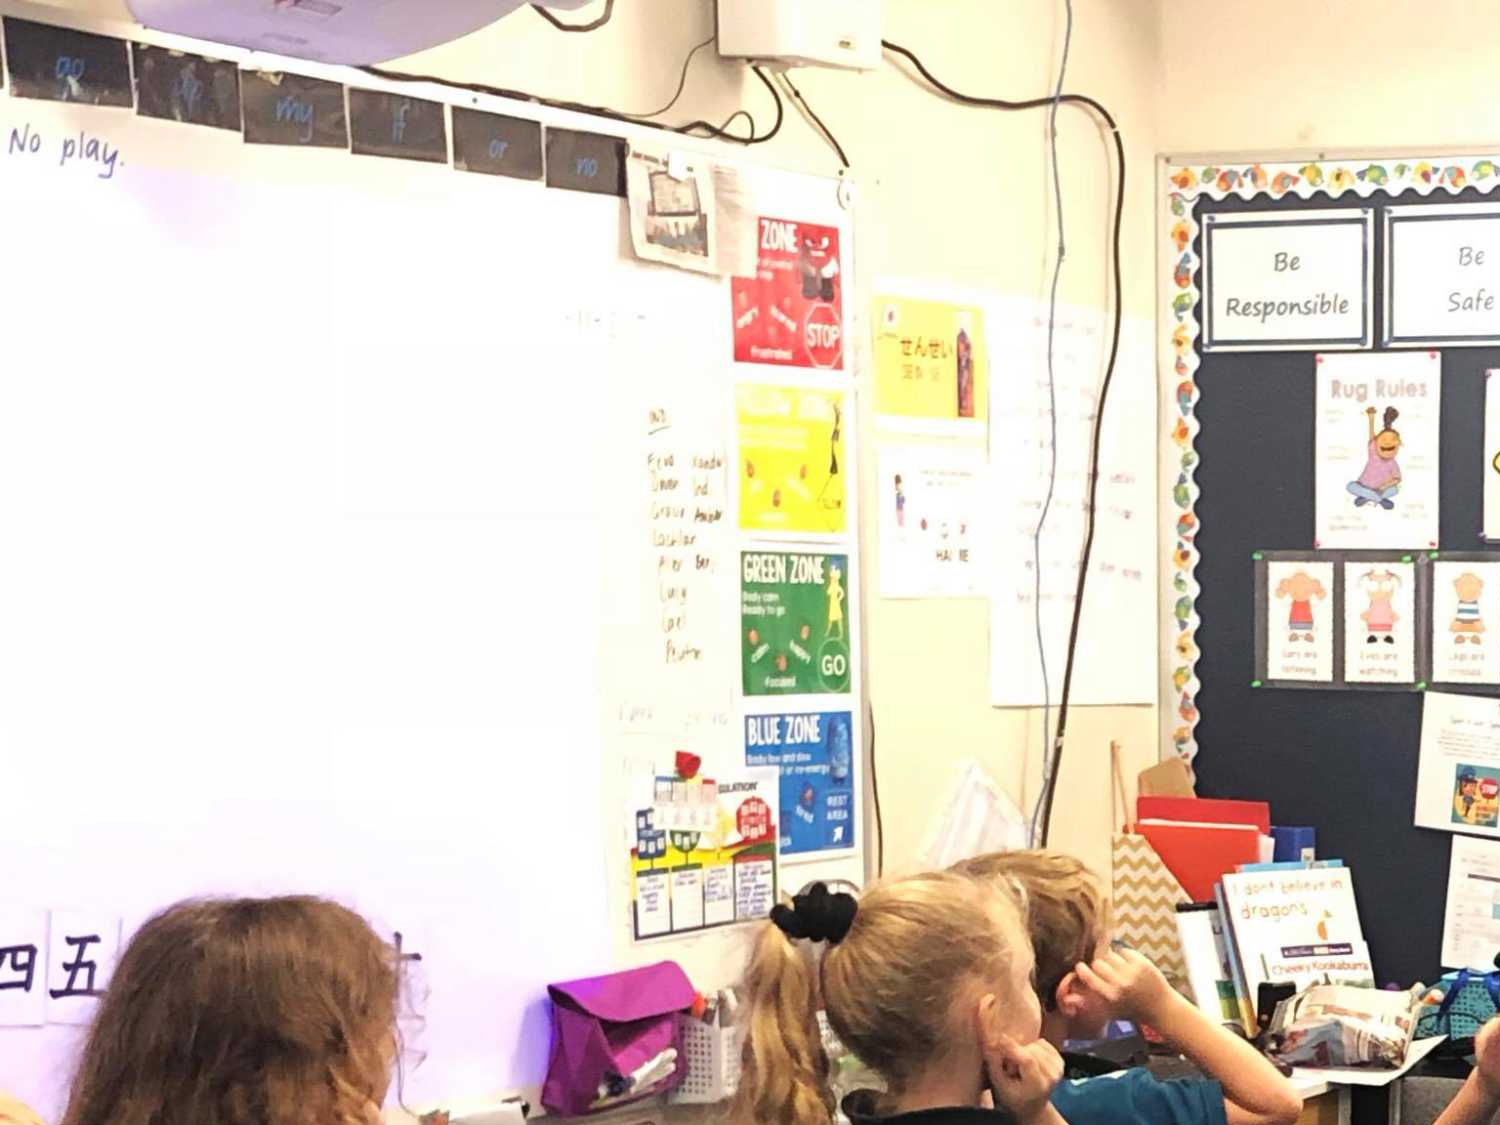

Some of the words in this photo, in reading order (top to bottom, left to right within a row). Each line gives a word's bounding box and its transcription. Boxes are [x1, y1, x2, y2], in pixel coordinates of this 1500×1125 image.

[9, 123, 41, 154] No
[60, 131, 124, 179] play.
[760, 219, 799, 253] ZONE
[1274, 252, 1301, 272] Be
[1458, 247, 1485, 266] Be
[1225, 293, 1350, 323] Responsible
[1448, 288, 1495, 312] Safe
[807, 322, 840, 348] STOP
[1331, 379, 1368, 402] Rug
[1375, 378, 1428, 398] Rules
[744, 553, 787, 583] GREEN
[789, 555, 825, 585] ZONE
[821, 654, 846, 676] GO
[747, 716, 781, 746] BLUE
[785, 714, 821, 745] ZONE
[1330, 879, 1343, 889] in
[1241, 901, 1308, 921] dragons
[49, 934, 109, 999] 五
[1272, 962, 1311, 975] Cheeky
